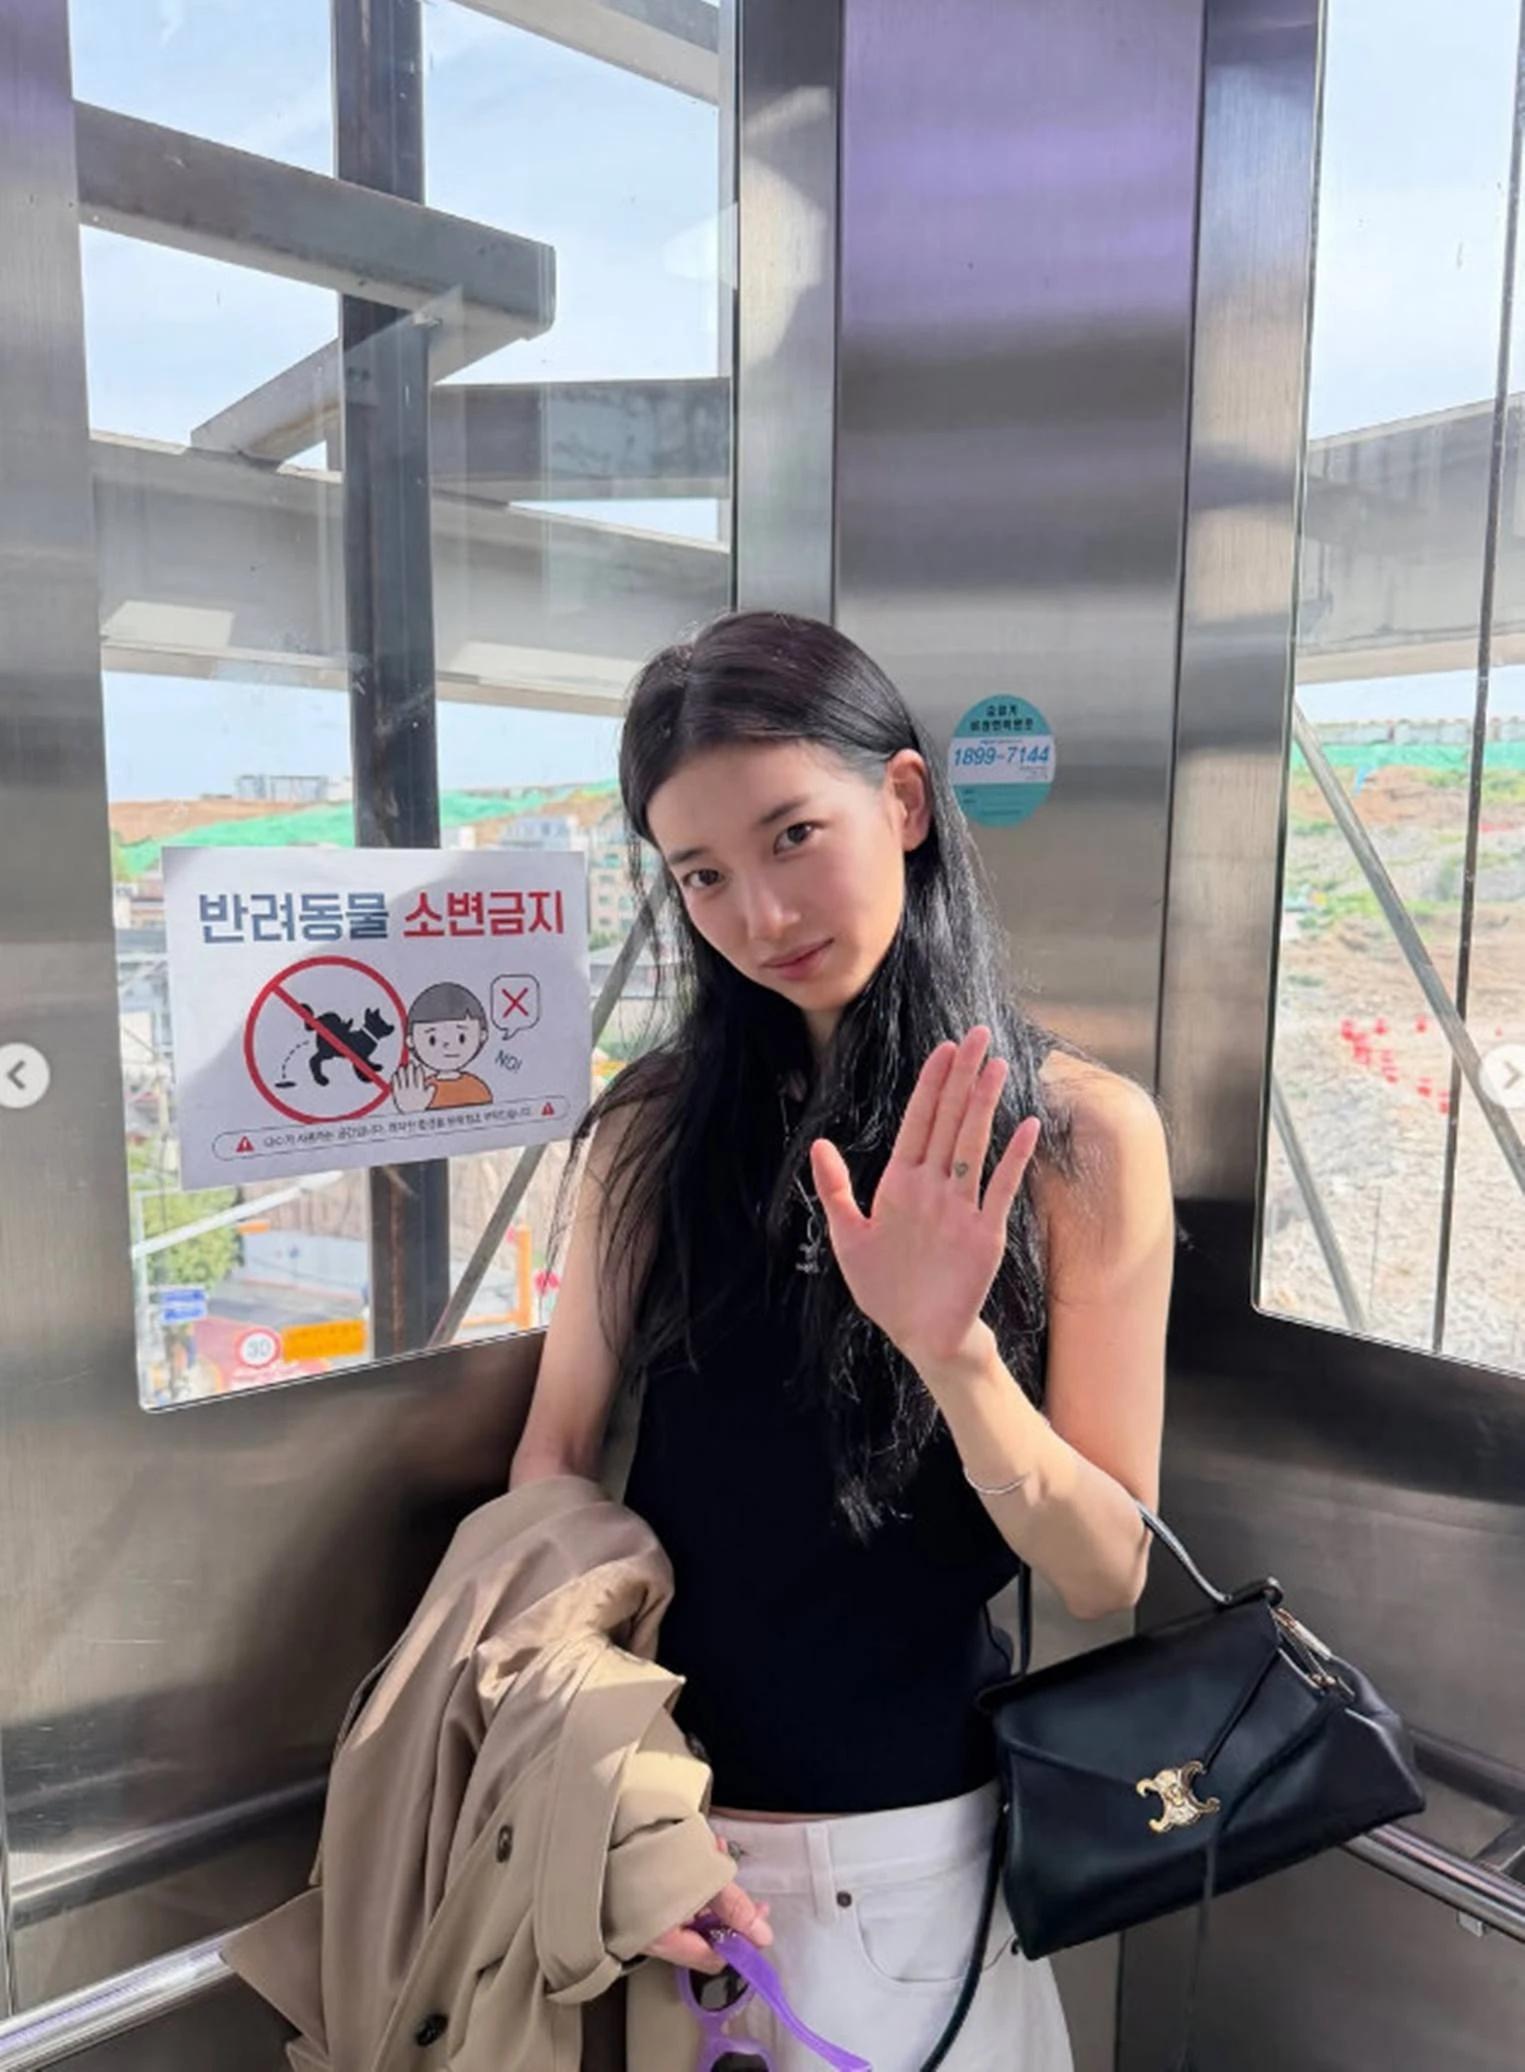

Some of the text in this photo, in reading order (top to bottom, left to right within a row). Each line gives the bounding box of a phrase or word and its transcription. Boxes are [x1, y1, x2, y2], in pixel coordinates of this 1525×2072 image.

[955, 745, 1049, 766] 1899-7144
[199, 890, 564, 943] 반려동물 소변금지
